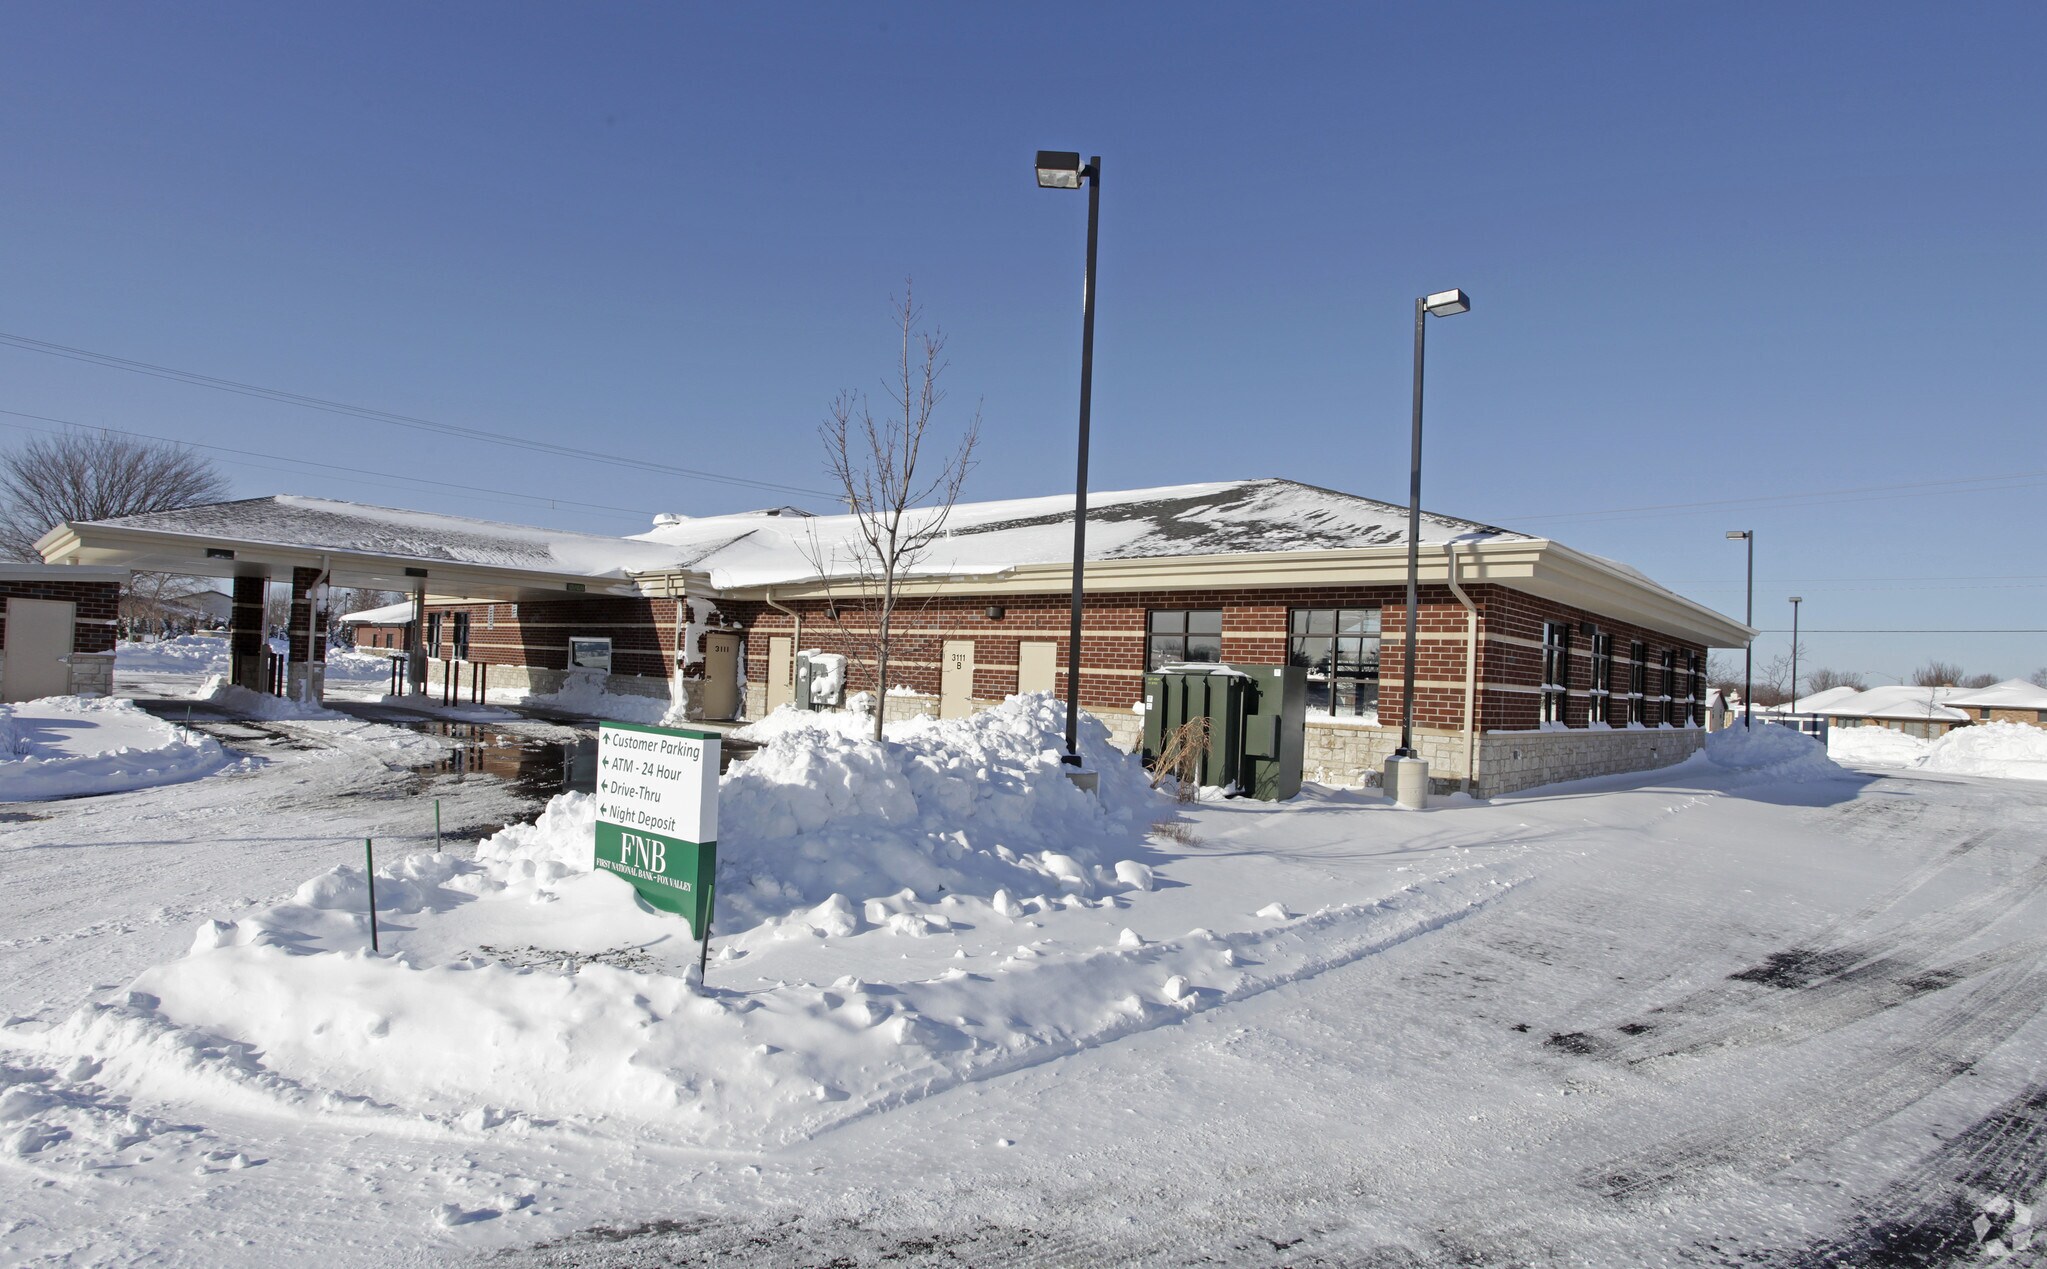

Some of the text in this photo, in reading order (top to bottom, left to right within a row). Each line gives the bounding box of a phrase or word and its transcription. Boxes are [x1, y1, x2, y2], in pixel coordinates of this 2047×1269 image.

[612, 733, 700, 762] Customer Parking
[611, 757, 634, 773] ATM
[641, 762, 654, 777] 24
[656, 764, 682, 781] Hour
[610, 780, 661, 803] Drive-Thru
[609, 805, 676, 832] Night Deposit
[620, 832, 666, 874] FNB
[596, 857, 612, 869] FIRST
[611, 861, 638, 877] NATIONAL
[669, 878, 693, 892] VALLEY
